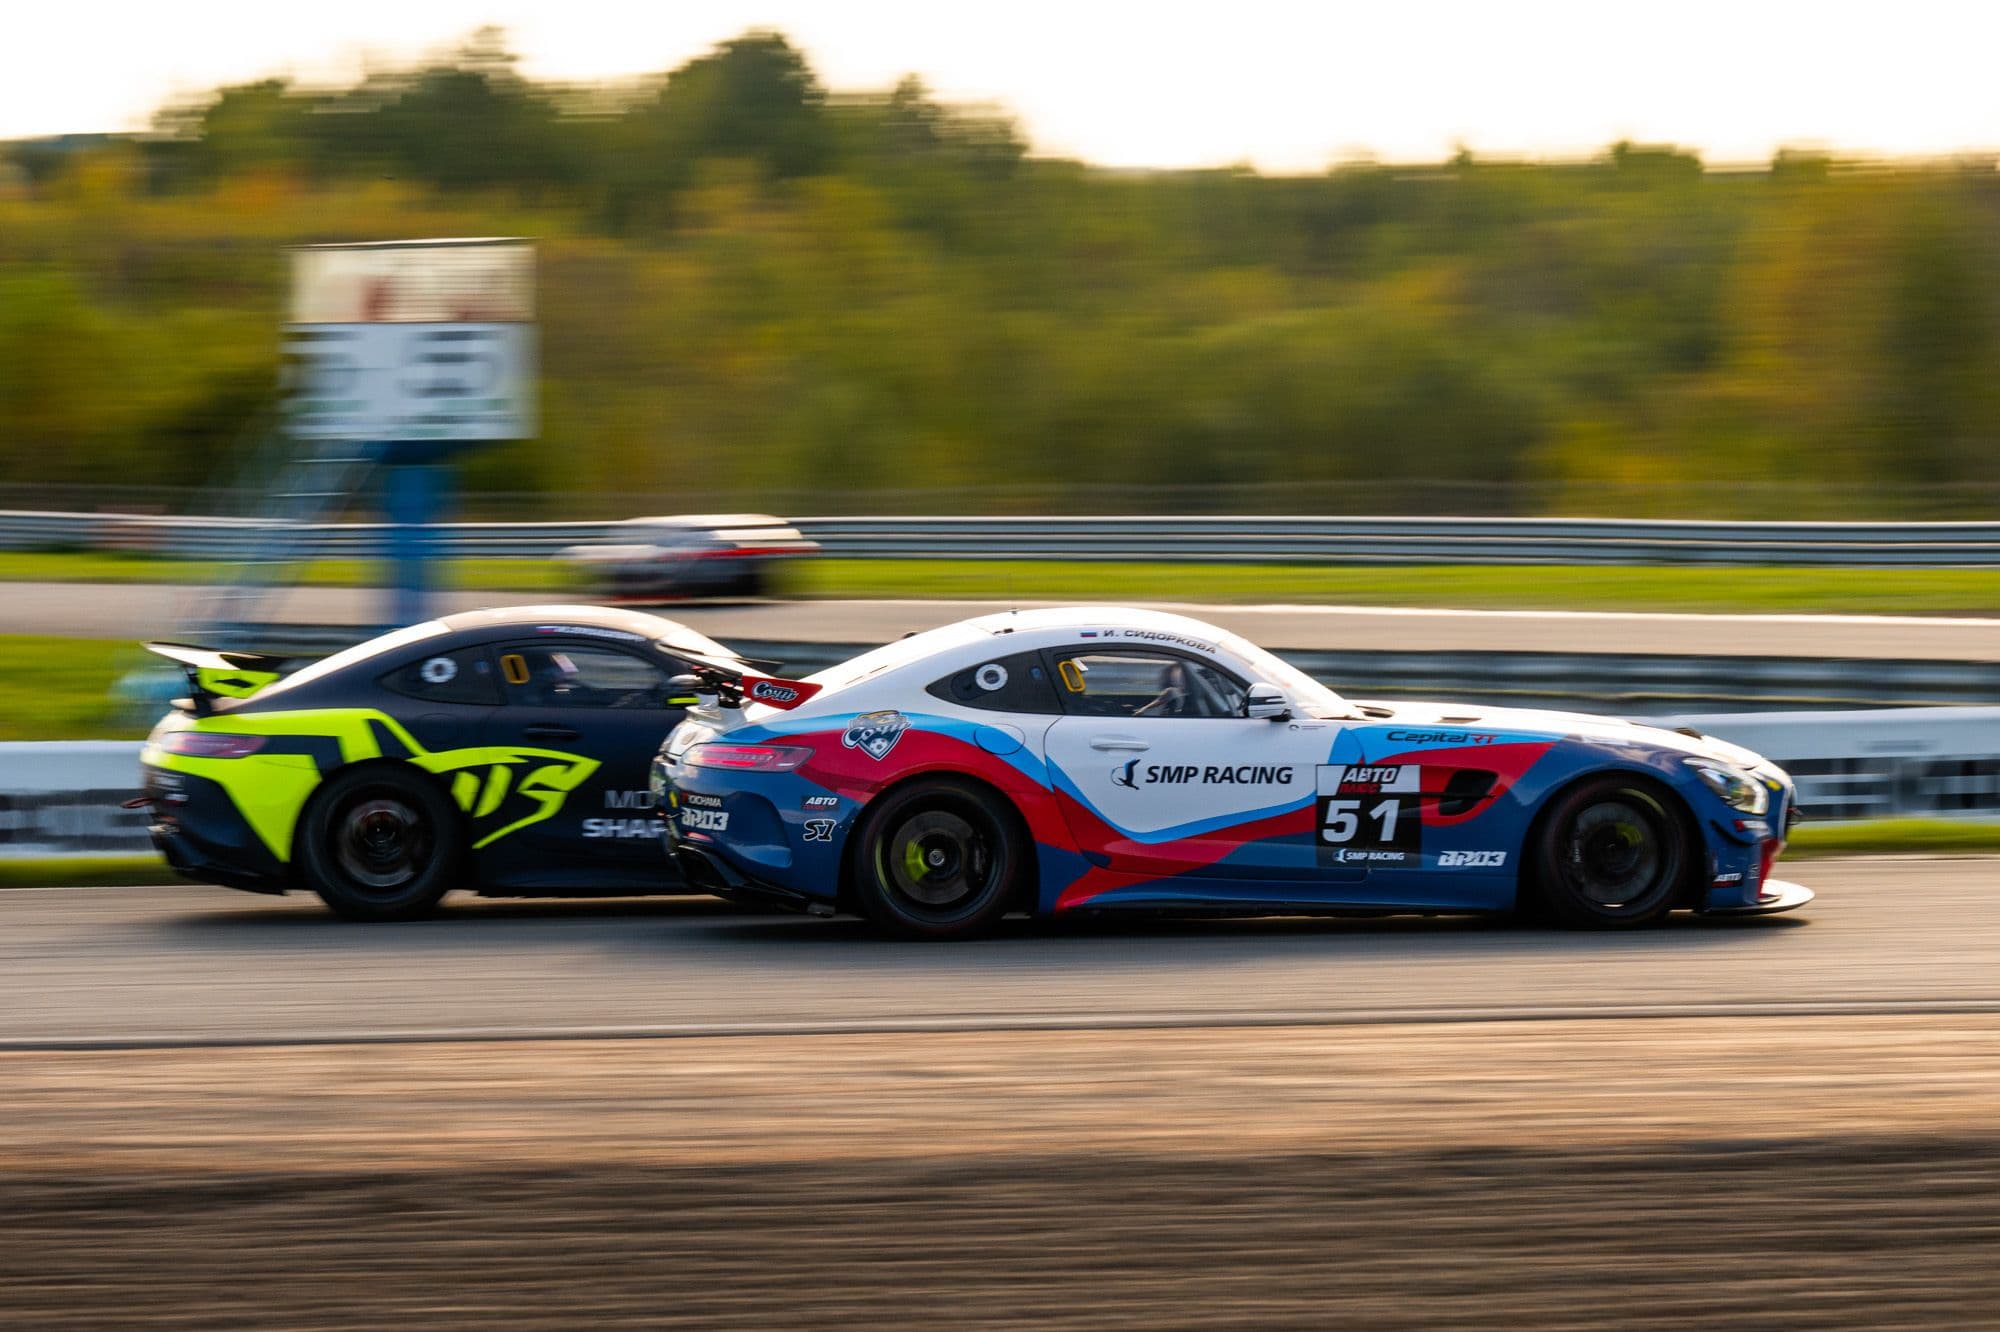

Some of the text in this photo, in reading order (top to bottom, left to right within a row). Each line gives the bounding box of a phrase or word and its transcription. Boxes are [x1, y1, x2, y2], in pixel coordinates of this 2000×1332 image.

[1103, 629, 1217, 654] И. СИДОРКОВА
[1145, 766, 1294, 784] SMP RACING
[1322, 799, 1400, 844] 51
[1346, 852, 1405, 861] SMP RACING
